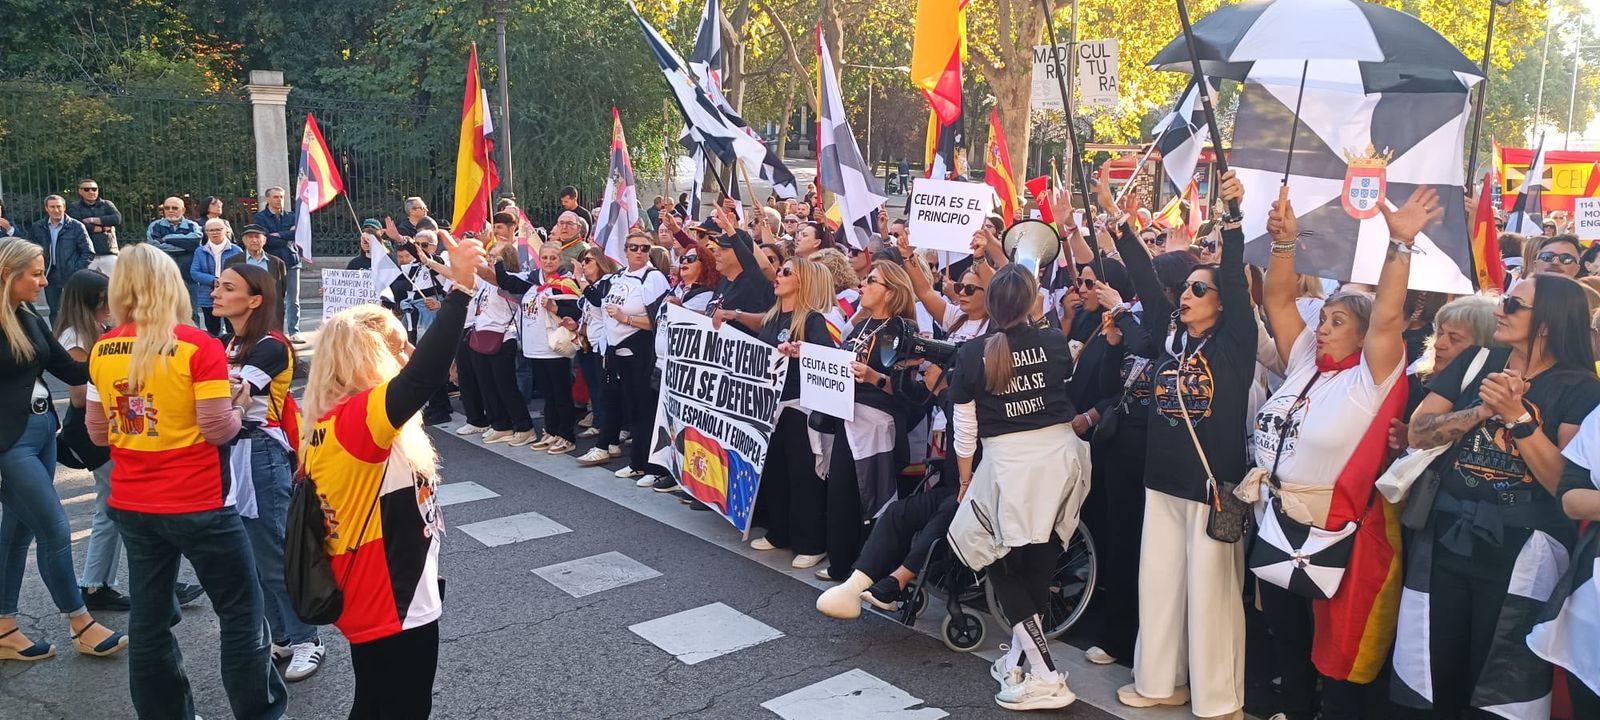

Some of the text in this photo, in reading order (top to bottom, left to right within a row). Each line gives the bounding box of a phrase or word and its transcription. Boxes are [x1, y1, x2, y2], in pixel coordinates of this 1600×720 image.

[1034, 47, 1066, 63] MAD
[1080, 43, 1110, 59] CUL
[1086, 59, 1107, 75] TU
[1099, 76, 1116, 91] RA
[914, 193, 982, 211] CEUTA ES EL
[918, 209, 970, 225] PRINCIPIO
[358, 289, 369, 297] 30
[667, 327, 703, 360] CEUTA
[703, 331, 722, 364] NO
[721, 337, 737, 368] SE
[1012, 347, 1048, 367] BALLA
[802, 357, 851, 379] CEUTA ES EL
[665, 359, 781, 424] CEUTA SE DEFIENDE
[806, 372, 845, 393] PRINCIPIO
[997, 372, 1046, 395] UNCA SE
[1005, 396, 1045, 418] RINDE!!
[681, 403, 724, 439] ESPAÑOLA
[724, 421, 732, 442] Y
[730, 426, 762, 467] EUROPEA
[1473, 434, 1481, 452] CEUTA
